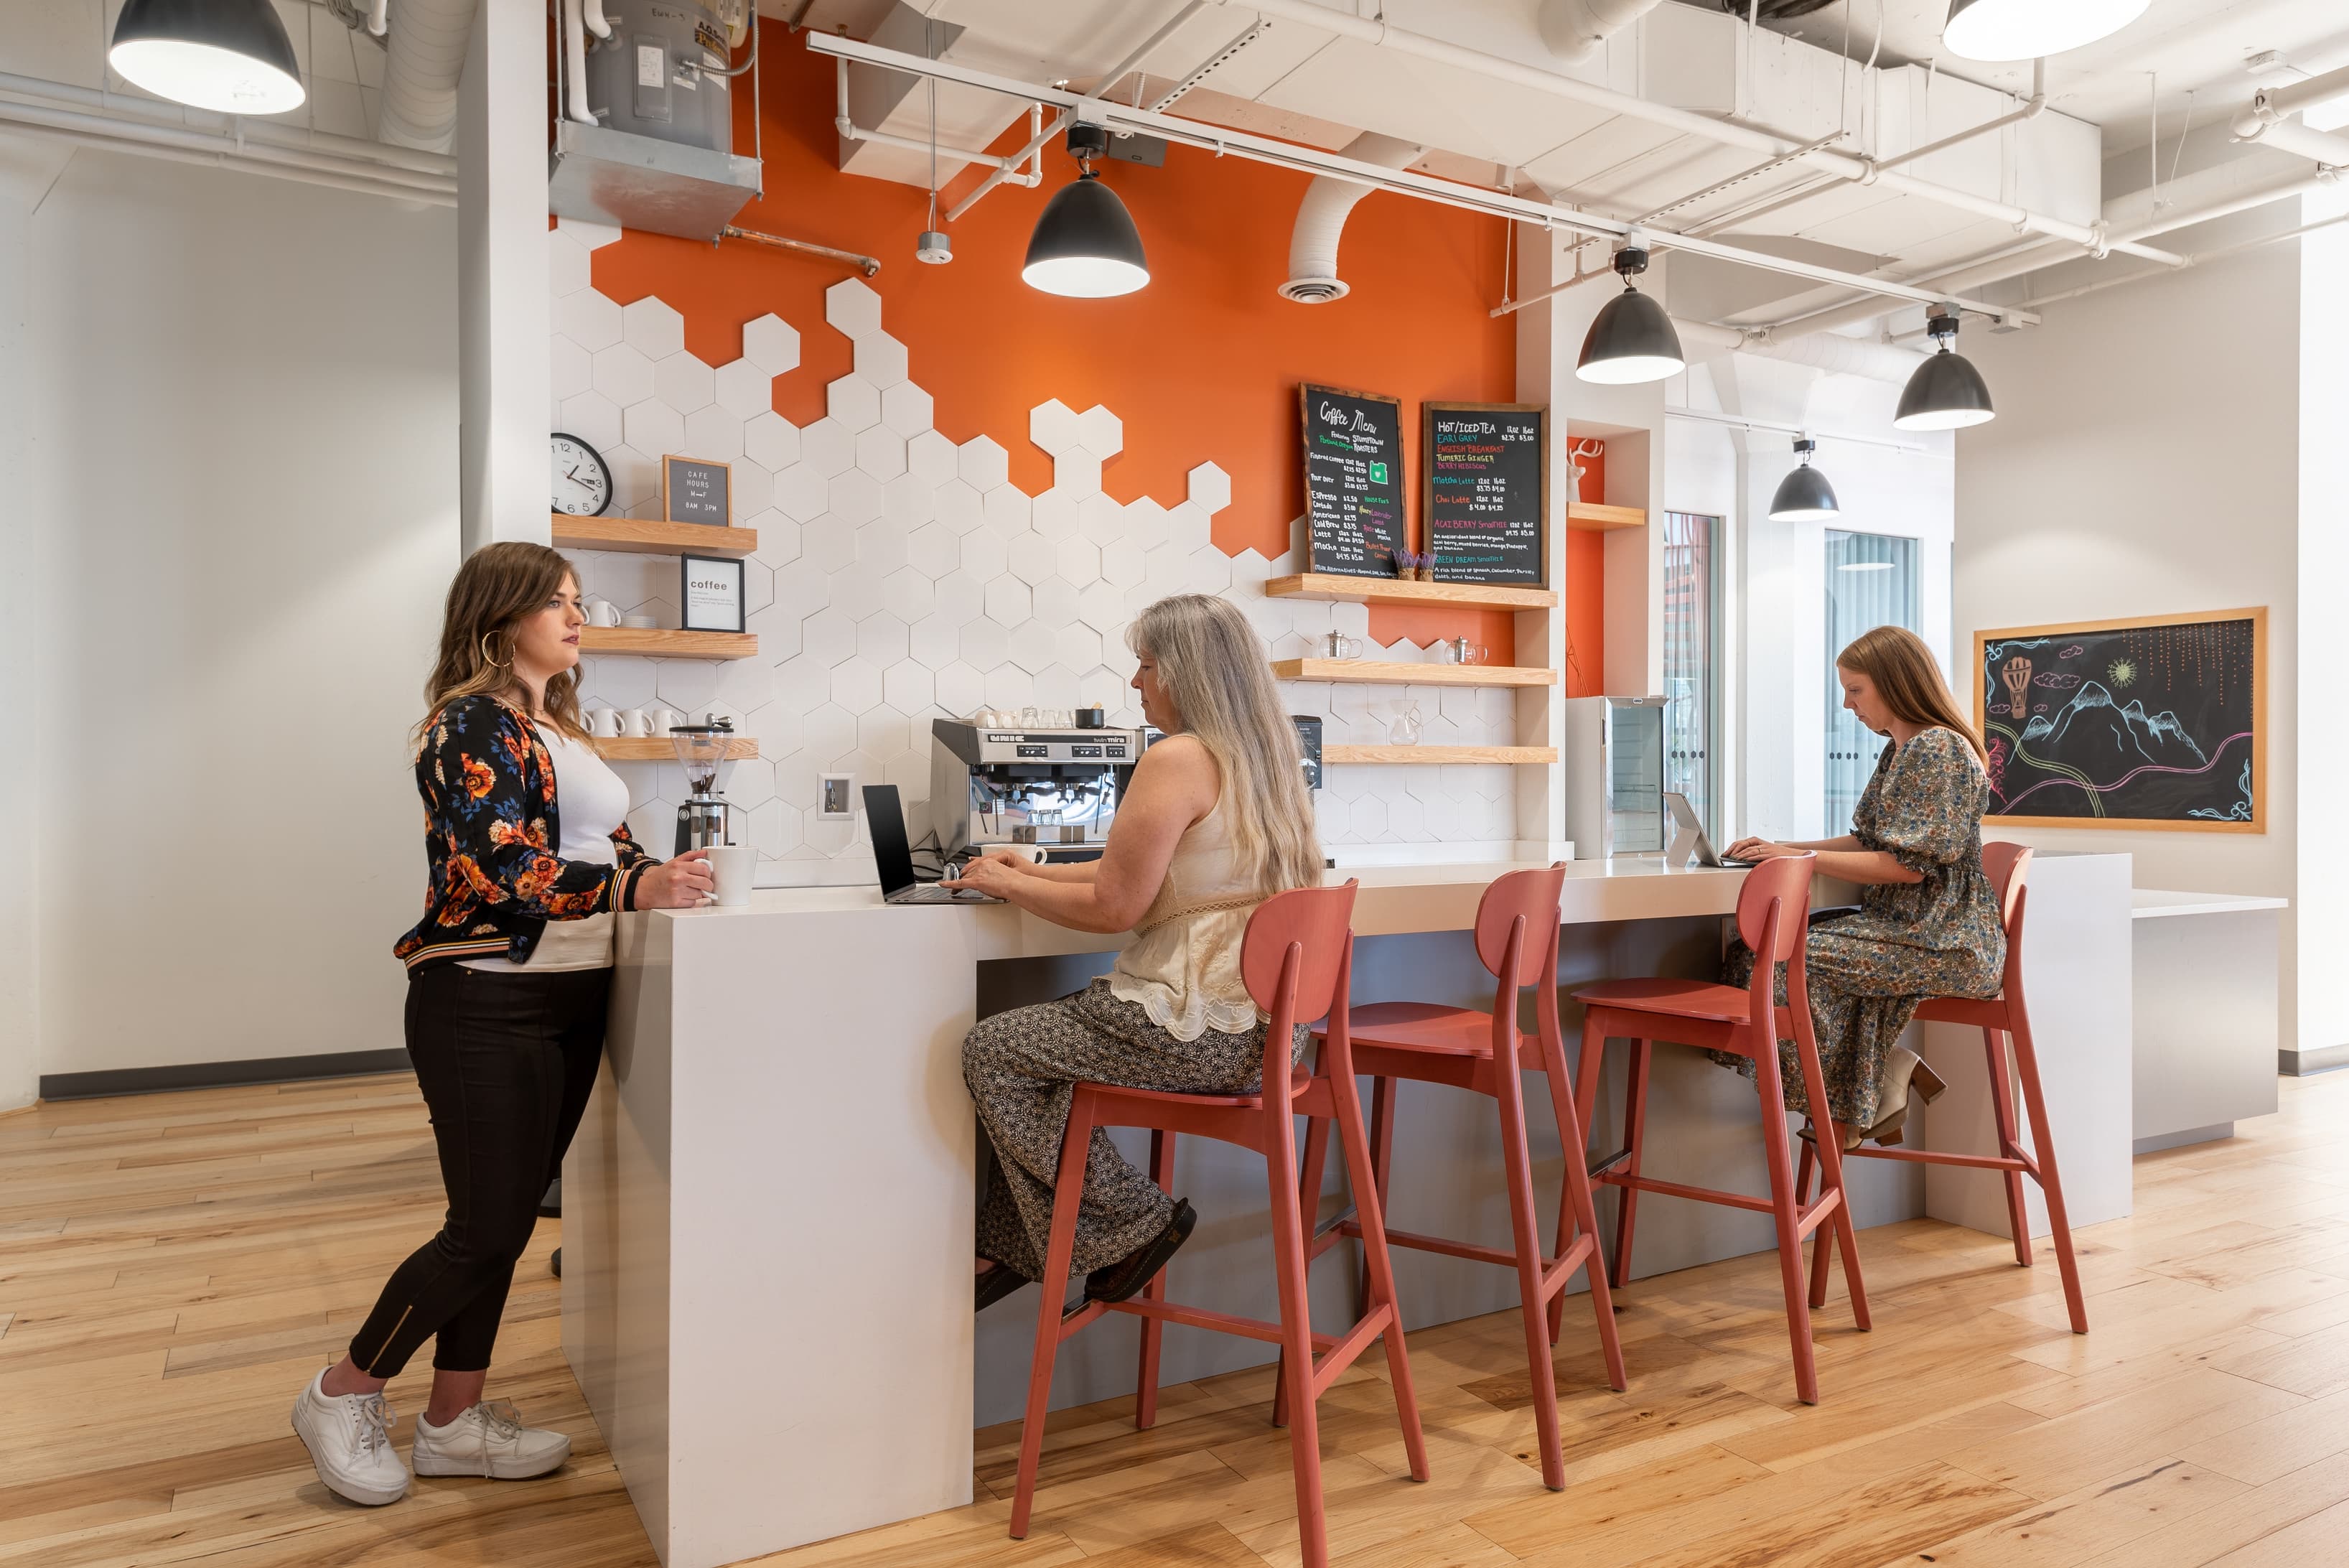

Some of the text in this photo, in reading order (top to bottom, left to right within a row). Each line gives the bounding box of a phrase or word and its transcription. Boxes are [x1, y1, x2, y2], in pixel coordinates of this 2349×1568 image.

[1320, 401, 1377, 434] Coffee Menu
[1479, 422, 1496, 434] TEA
[1331, 431, 1350, 443] Featuring
[1458, 434, 1477, 443] GREY
[560, 443, 571, 453] 12
[1353, 443, 1378, 453] ROASTERS
[1437, 444, 1505, 454] ENGLISH BREAKFAST
[1436, 454, 1495, 464] TUMERIC GINGER
[589, 464, 597, 473] 2
[688, 471, 708, 480] CAFE
[596, 479, 602, 488] 3
[686, 479, 709, 488] HOURS
[592, 494, 599, 503] 4
[1312, 490, 1337, 501] Espresso
[1436, 494, 1450, 503] Chai
[551, 497, 559, 506] 7
[1312, 500, 1332, 510] Cortado
[567, 504, 575, 513] 6
[582, 503, 589, 512] 5
[1434, 519, 1452, 528] ACAI
[1453, 519, 1477, 529] BERRY
[1314, 529, 1332, 538] Latte
[1314, 542, 1337, 551] Mocha
[691, 580, 727, 590] coffee
